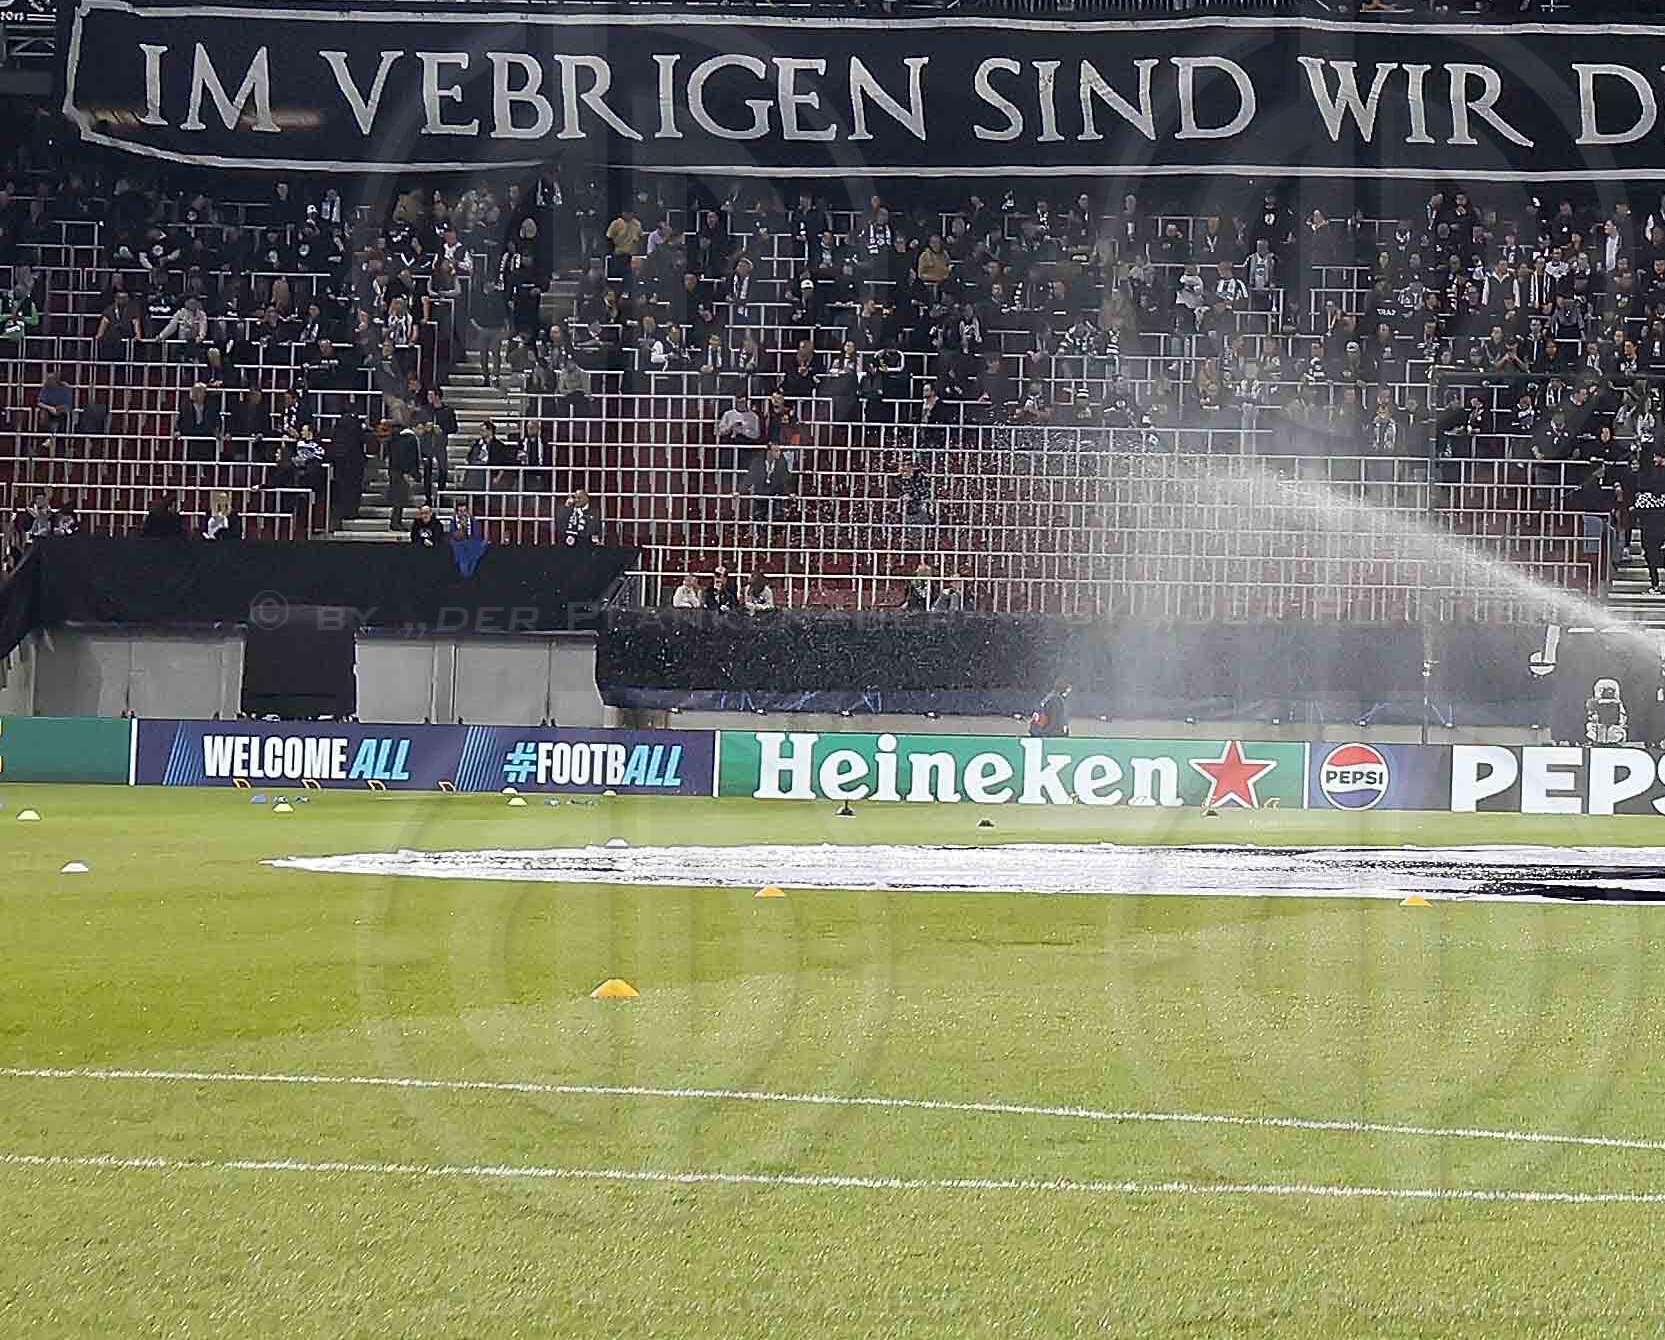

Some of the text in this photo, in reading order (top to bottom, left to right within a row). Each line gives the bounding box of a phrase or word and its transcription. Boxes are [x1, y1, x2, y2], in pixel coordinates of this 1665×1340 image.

[138, 42, 282, 132] IM
[318, 50, 929, 141] VEBRIGEN
[973, 56, 1256, 141] SIND
[1297, 56, 1534, 148] WIR
[203, 735, 410, 781] WELCOME ALL
[502, 740, 684, 787] #FOOTBALL
[752, 732, 1184, 806] Heineken
[1325, 769, 1384, 787] PEPSI
